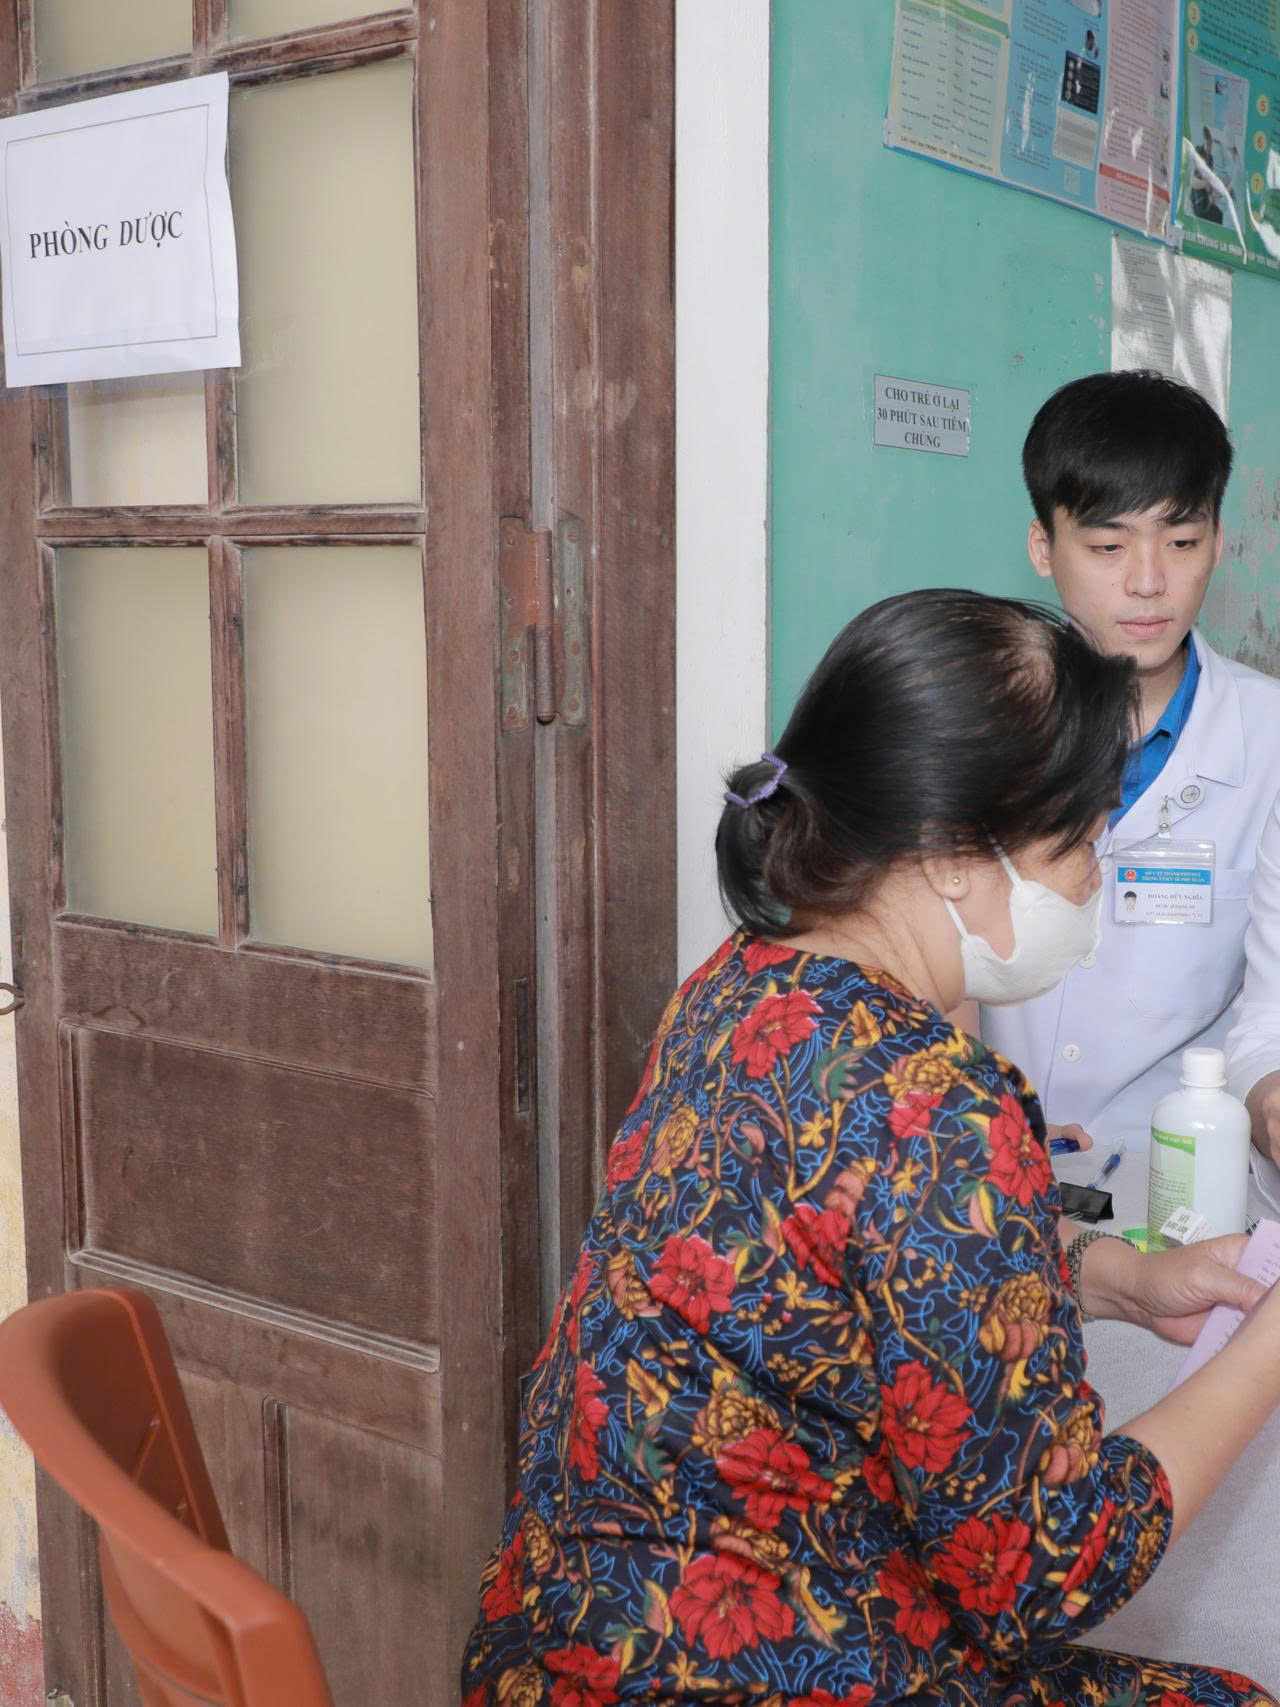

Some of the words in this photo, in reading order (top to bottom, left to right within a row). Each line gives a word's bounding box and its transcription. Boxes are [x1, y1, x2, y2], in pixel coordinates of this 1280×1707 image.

[29, 220, 109, 259] PHÒNG
[119, 210, 183, 248] DƯỢC
[885, 386, 909, 402] CHO
[943, 396, 960, 413] LẠI
[877, 407, 888, 421] 30
[890, 408, 918, 425] PHÚT
[919, 413, 940, 429] SAU
